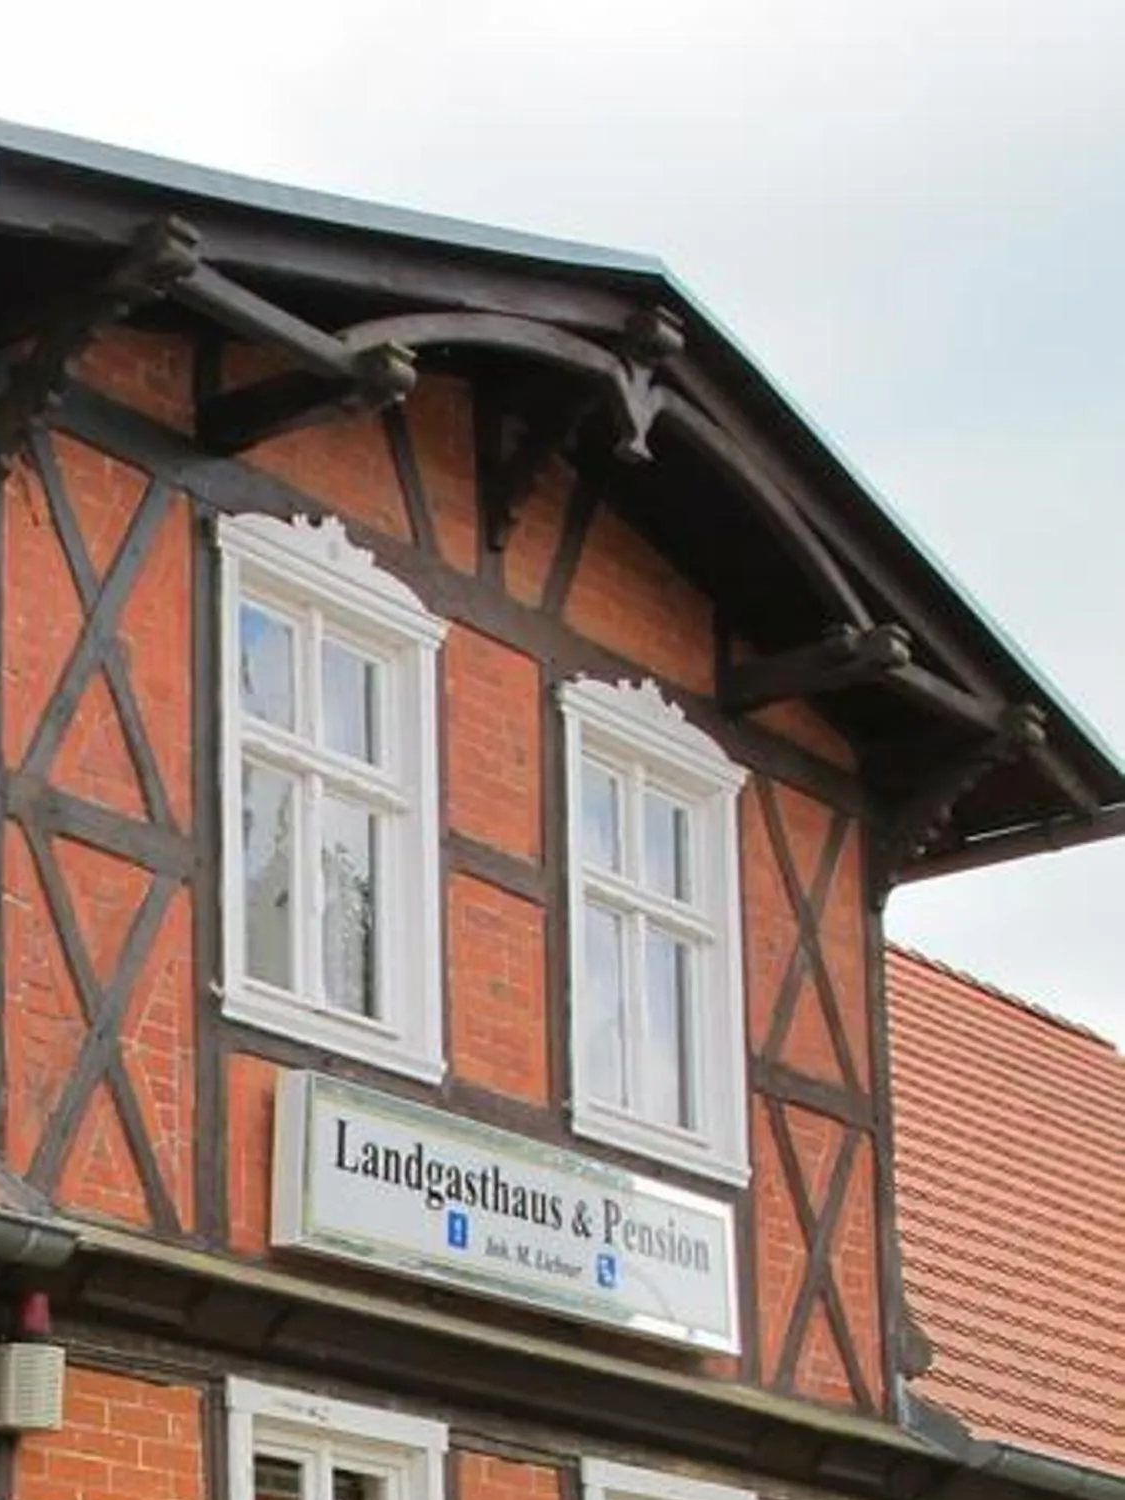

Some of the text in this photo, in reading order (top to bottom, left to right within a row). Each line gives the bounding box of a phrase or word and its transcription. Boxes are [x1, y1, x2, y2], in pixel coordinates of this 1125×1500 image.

[335, 1119, 710, 1273] Landgasthaus & Pension
